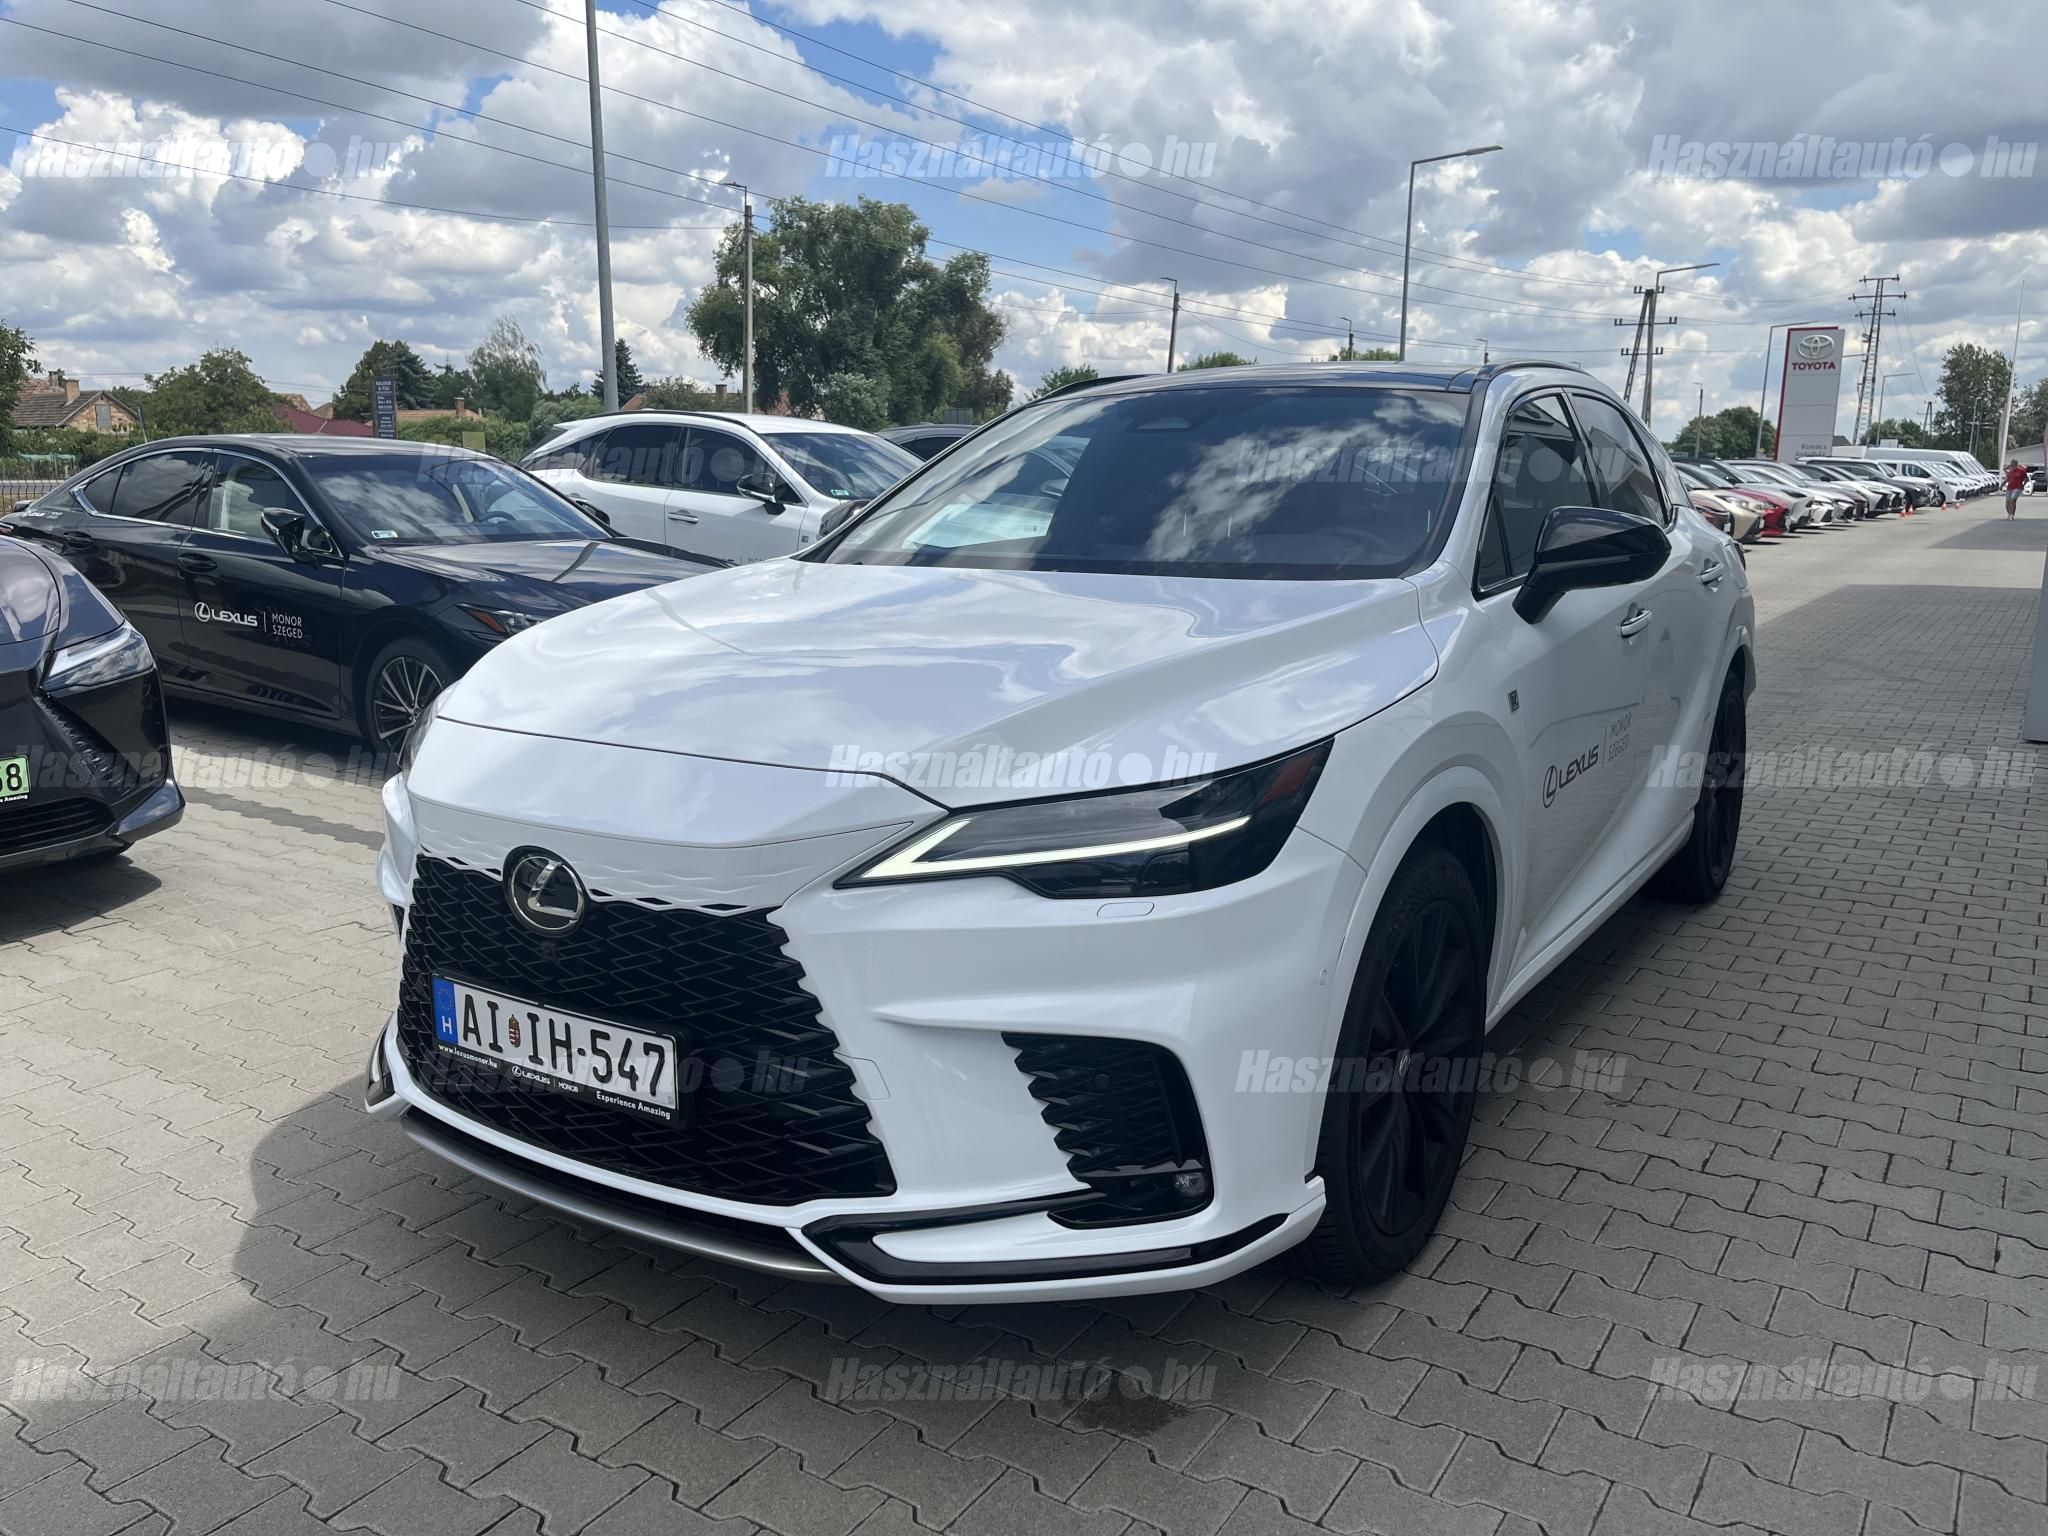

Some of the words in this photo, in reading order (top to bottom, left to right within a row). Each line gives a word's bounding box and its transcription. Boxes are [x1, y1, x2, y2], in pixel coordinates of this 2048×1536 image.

[1792, 362, 1836, 371] TOYOTA
[211, 608, 258, 627] LEXUS
[272, 613, 302, 627] MONOR
[272, 625, 303, 639] SZEGED
[1559, 744, 1600, 789] LEXUS
[441, 1015, 453, 1035] H
[438, 1043, 498, 1069] www.lexusmonor.hu
[521, 1070, 551, 1085] LEXUS
[558, 1081, 579, 1093] MONOR
[596, 1090, 637, 1110] Experience
[637, 1101, 671, 1120] Amazing
